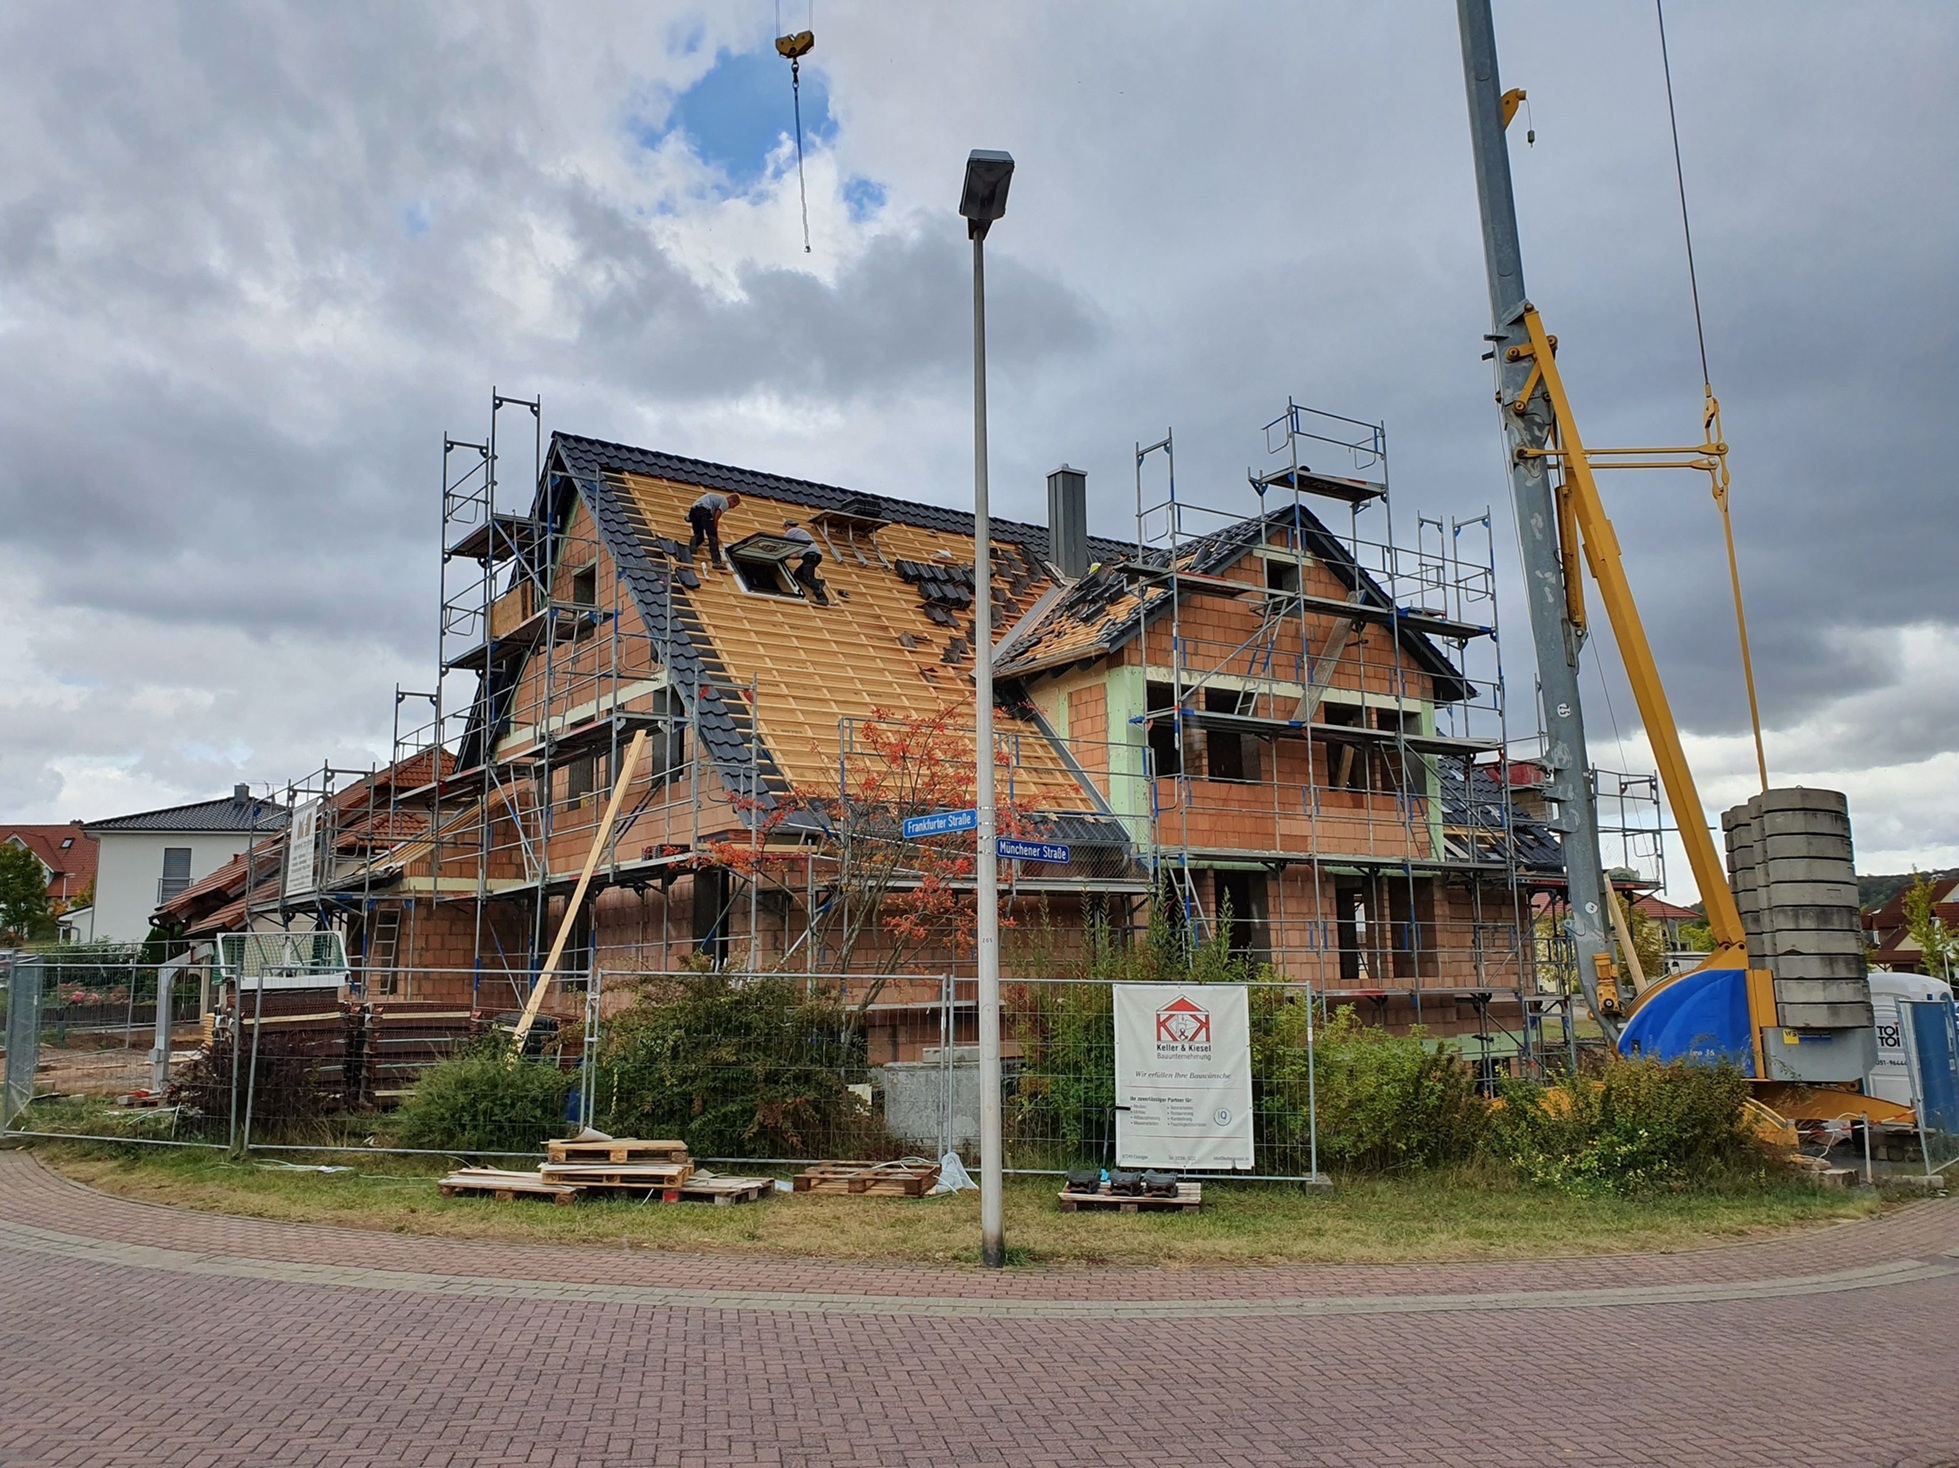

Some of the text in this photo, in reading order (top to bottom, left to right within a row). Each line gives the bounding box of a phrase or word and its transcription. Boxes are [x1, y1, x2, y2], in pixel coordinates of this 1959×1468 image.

[908, 813, 971, 834] Frankfurter Straße
[1000, 841, 1067, 860] Münchener Straße
[1878, 1036, 1901, 1047] TOI
[1156, 1043, 1211, 1052] Keller & Kiesel
[1157, 1052, 1211, 1061] Bauunternehmung
[1135, 1070, 1146, 1078] Wir
[1147, 1071, 1173, 1079] erfüllen
